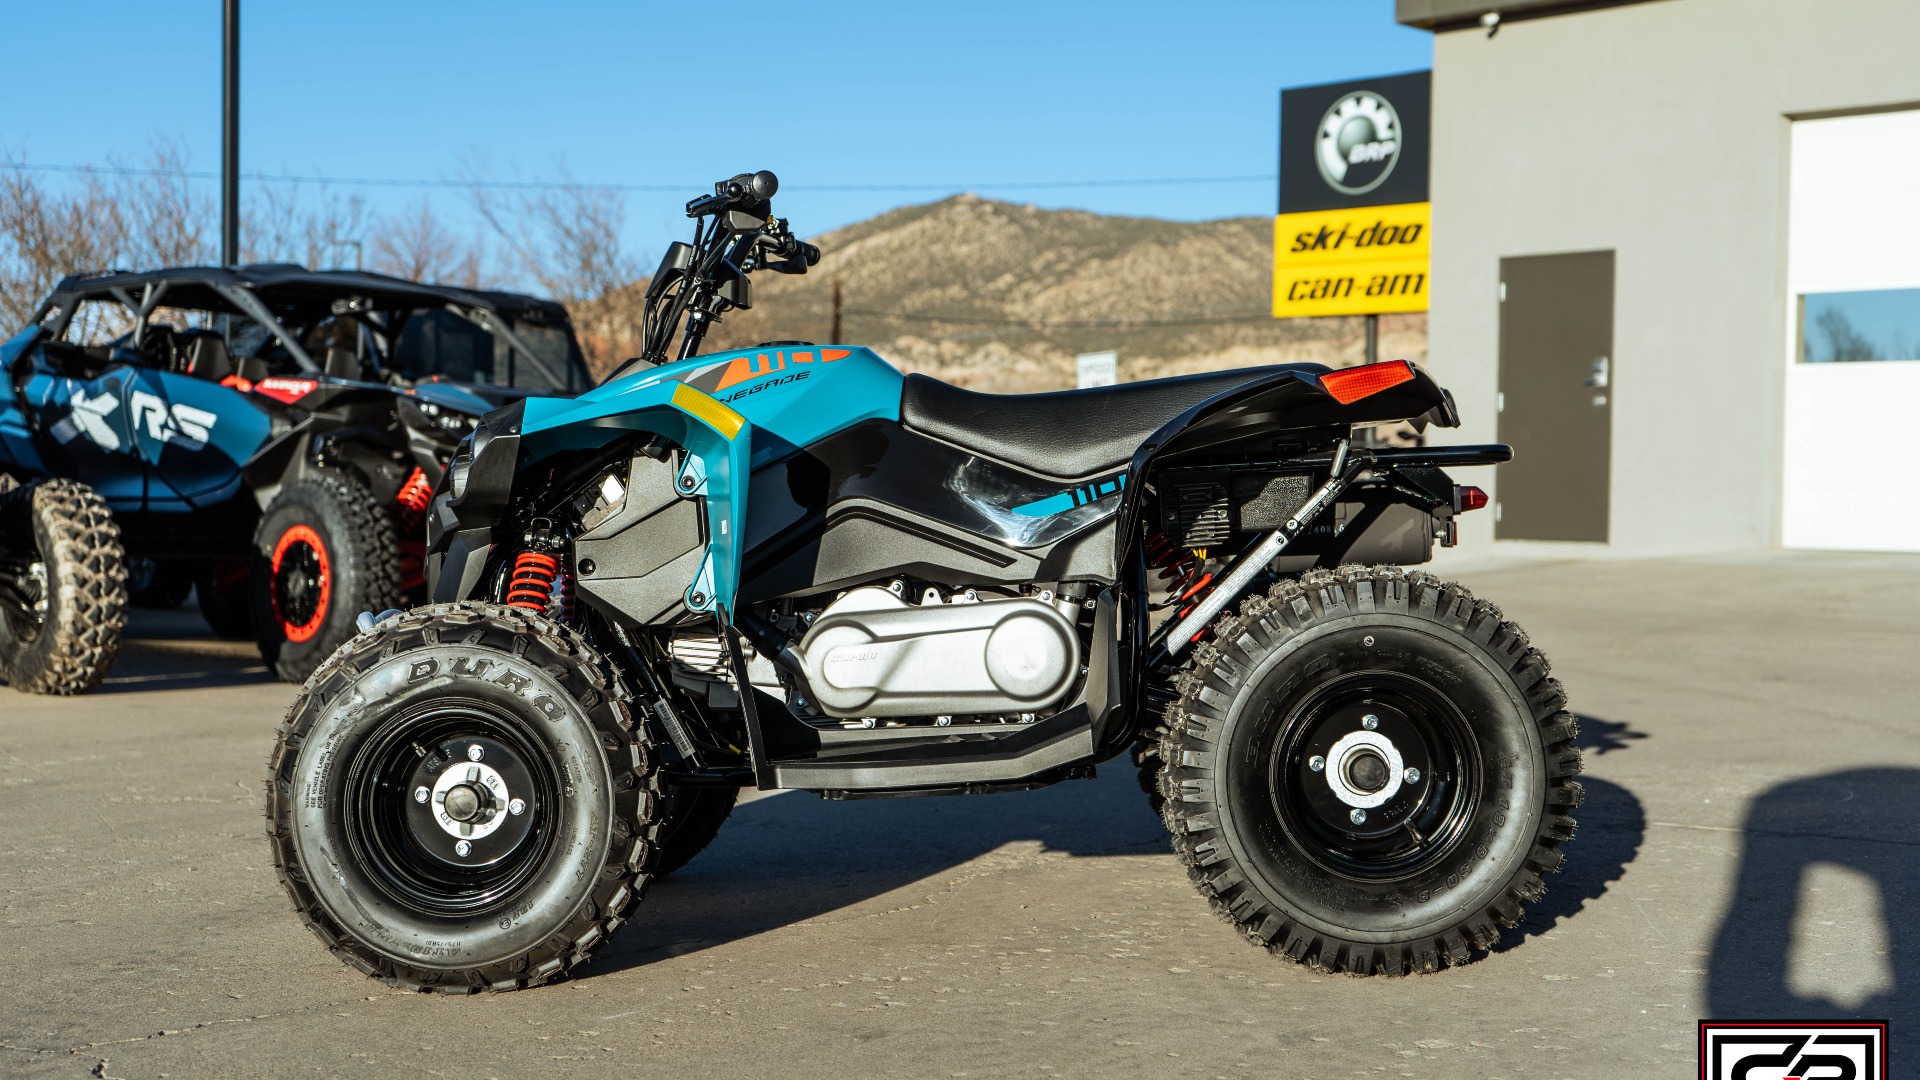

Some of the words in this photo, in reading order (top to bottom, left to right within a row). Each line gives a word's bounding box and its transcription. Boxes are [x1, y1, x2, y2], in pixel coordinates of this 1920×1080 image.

[1348, 139, 1396, 164] BRP
[1291, 221, 1423, 252] ski-doo
[1288, 273, 1425, 301] can-am
[408, 656, 567, 723] DURO
